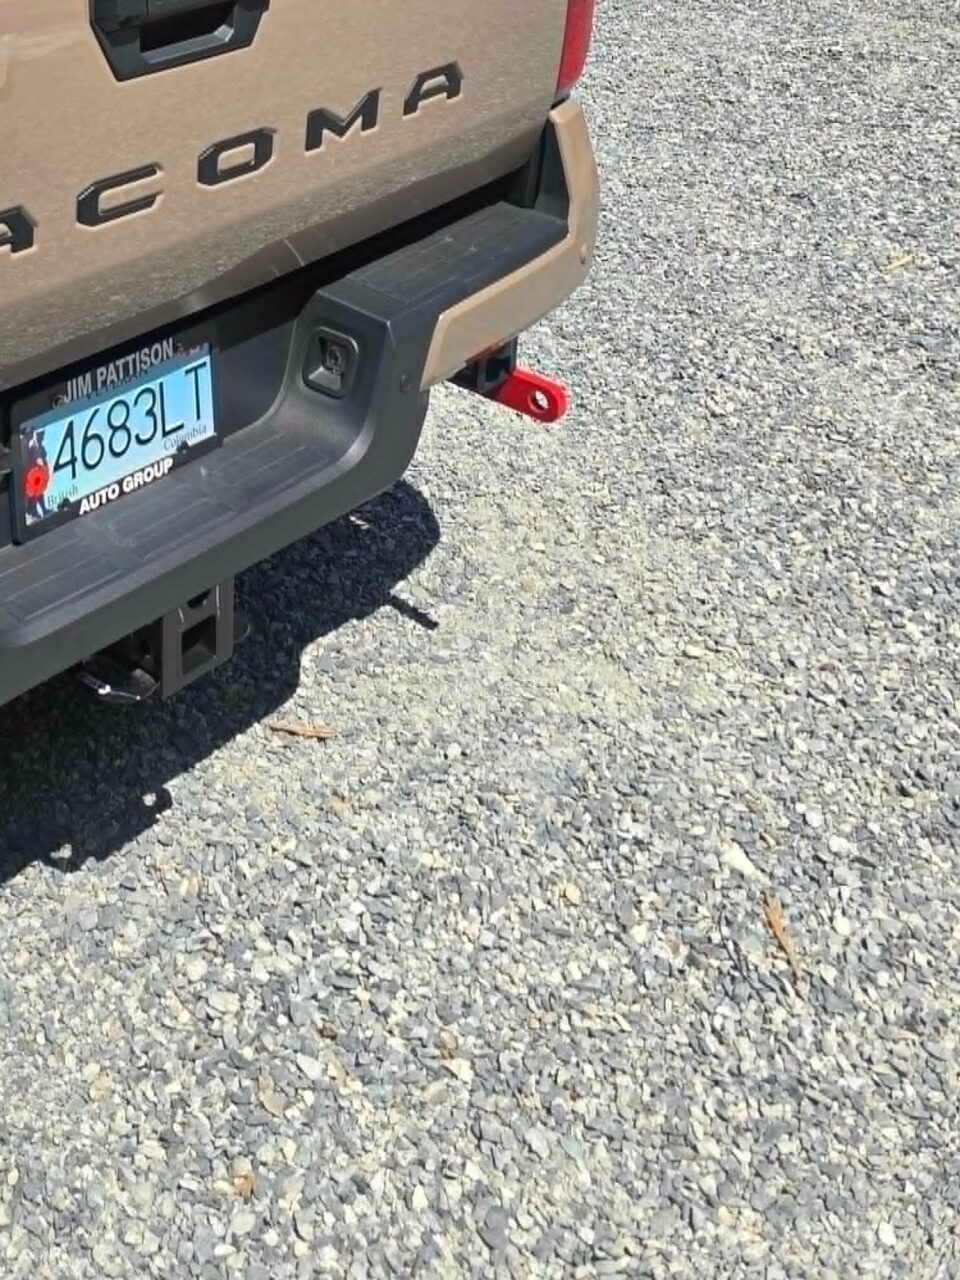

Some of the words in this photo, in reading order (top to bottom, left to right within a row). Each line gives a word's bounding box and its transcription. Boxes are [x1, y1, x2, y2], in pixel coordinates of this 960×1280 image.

[64, 374, 92, 404] JIM
[96, 337, 174, 389] PATTISON
[79, 483, 120, 516] AUTO
[122, 457, 174, 493] GROUP
